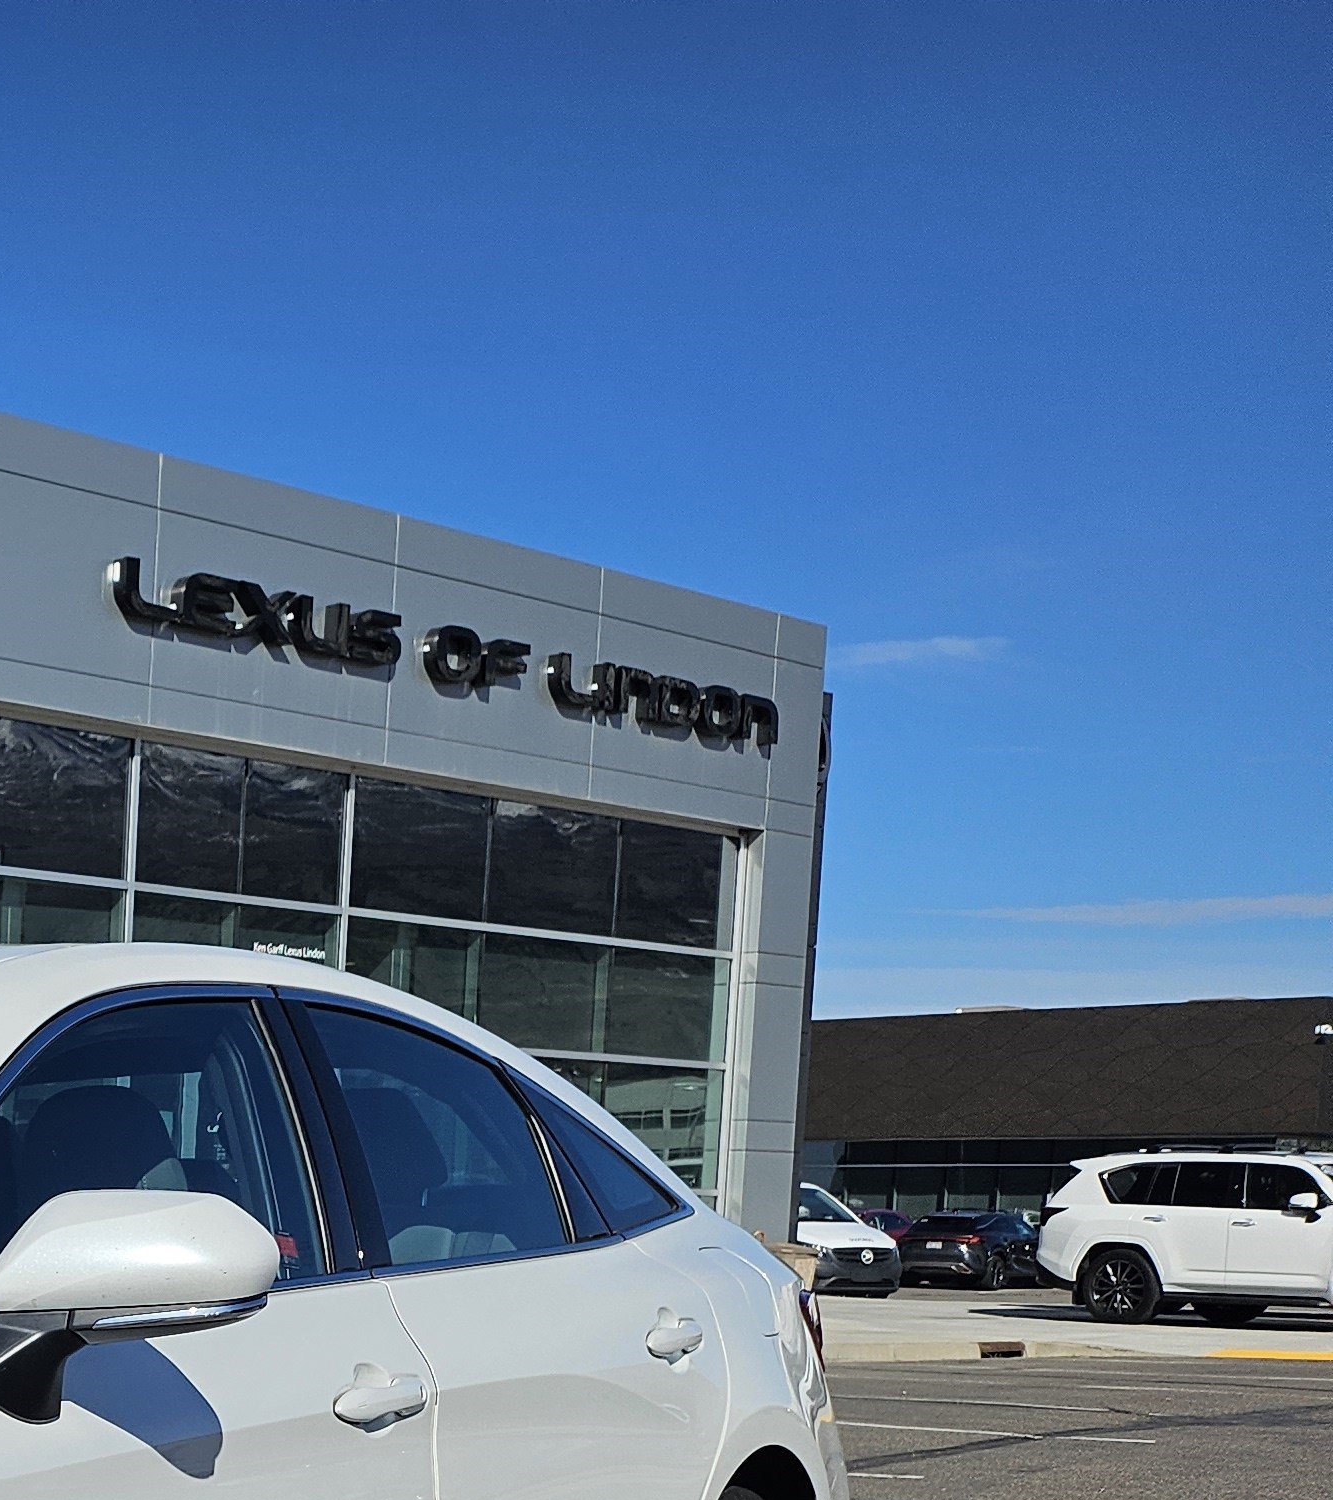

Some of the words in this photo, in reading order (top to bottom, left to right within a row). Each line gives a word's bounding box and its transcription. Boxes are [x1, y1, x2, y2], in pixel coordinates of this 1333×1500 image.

[106, 556, 402, 666] LEXUS
[422, 625, 531, 685] OF
[545, 652, 779, 745] LINDON
[253, 942, 266, 953] Ken
[284, 945, 302, 957] Lexus
[302, 946, 326, 960] Lindon
